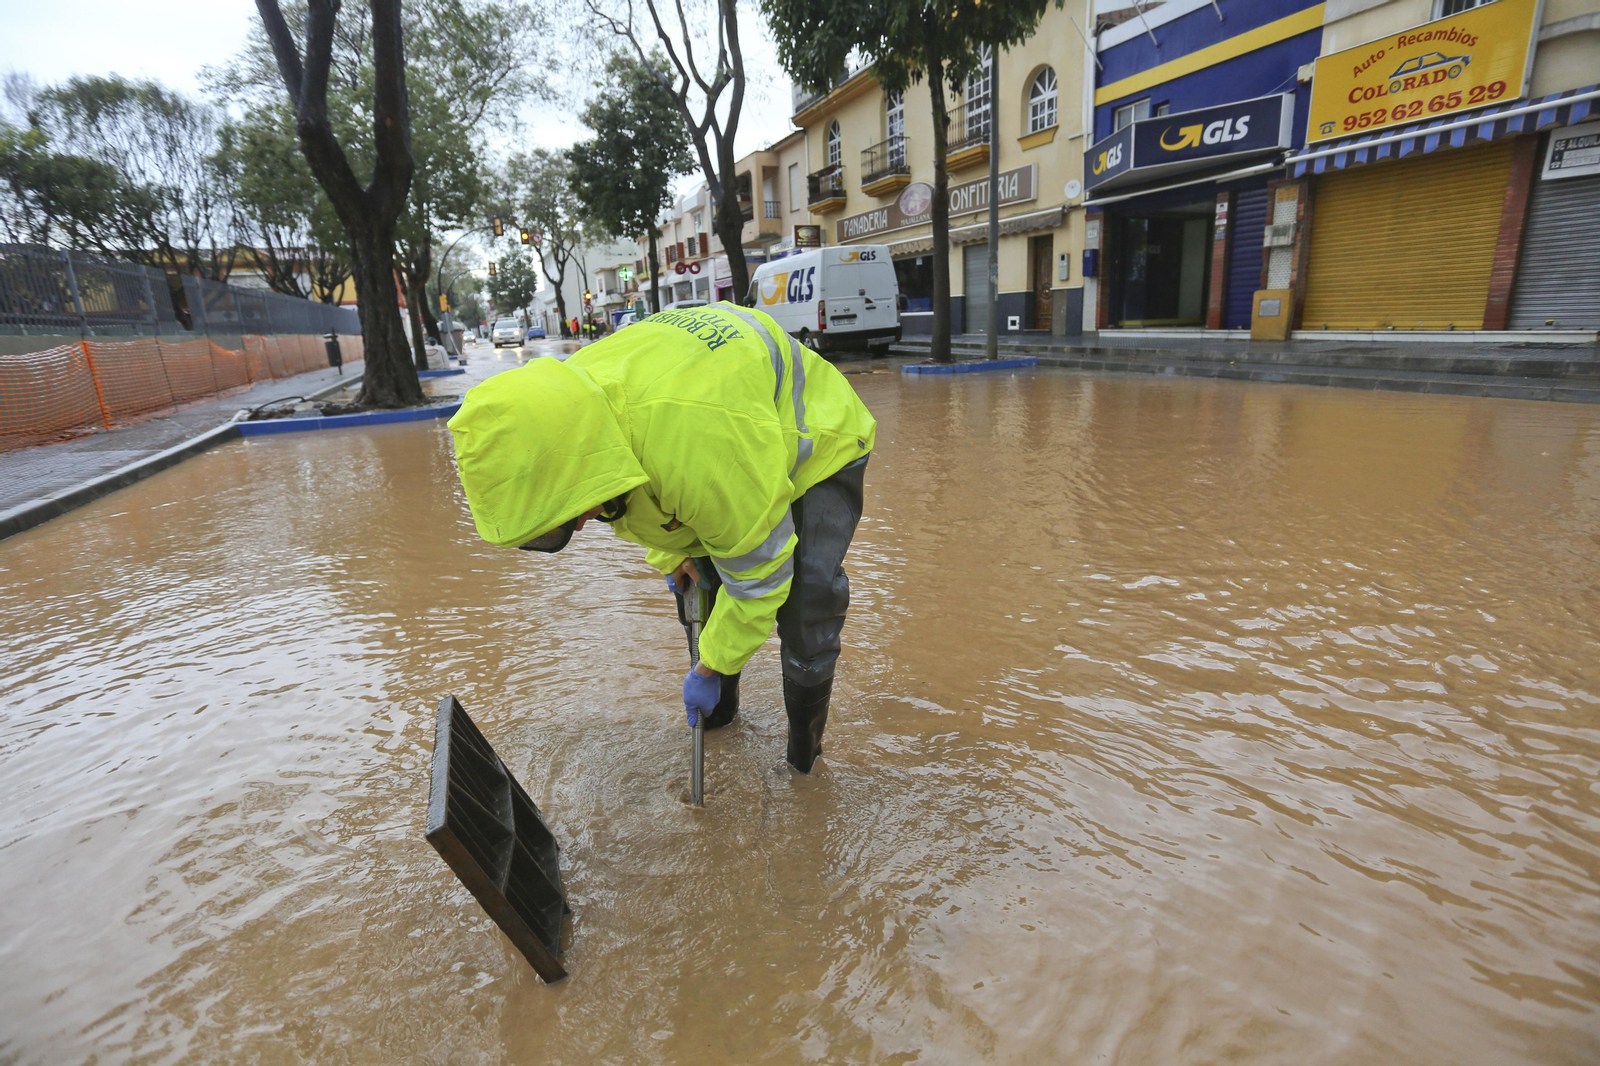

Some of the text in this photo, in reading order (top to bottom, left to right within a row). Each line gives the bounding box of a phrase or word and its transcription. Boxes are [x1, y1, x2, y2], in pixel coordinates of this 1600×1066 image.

[1353, 50, 1385, 78] Auto
[1398, 26, 1480, 49] Recambios
[1343, 80, 1507, 132] 952 62 65 29
[1203, 115, 1251, 145] GLS
[1554, 140, 1566, 151] SE
[1106, 142, 1122, 170] GLS
[844, 172, 1019, 238] PANADERIA ONFITRIA
[860, 250, 876, 262] GLS
[787, 266, 815, 303] GLS
[645, 312, 728, 351] RC BOMBE
[700, 313, 744, 340] AYTO
